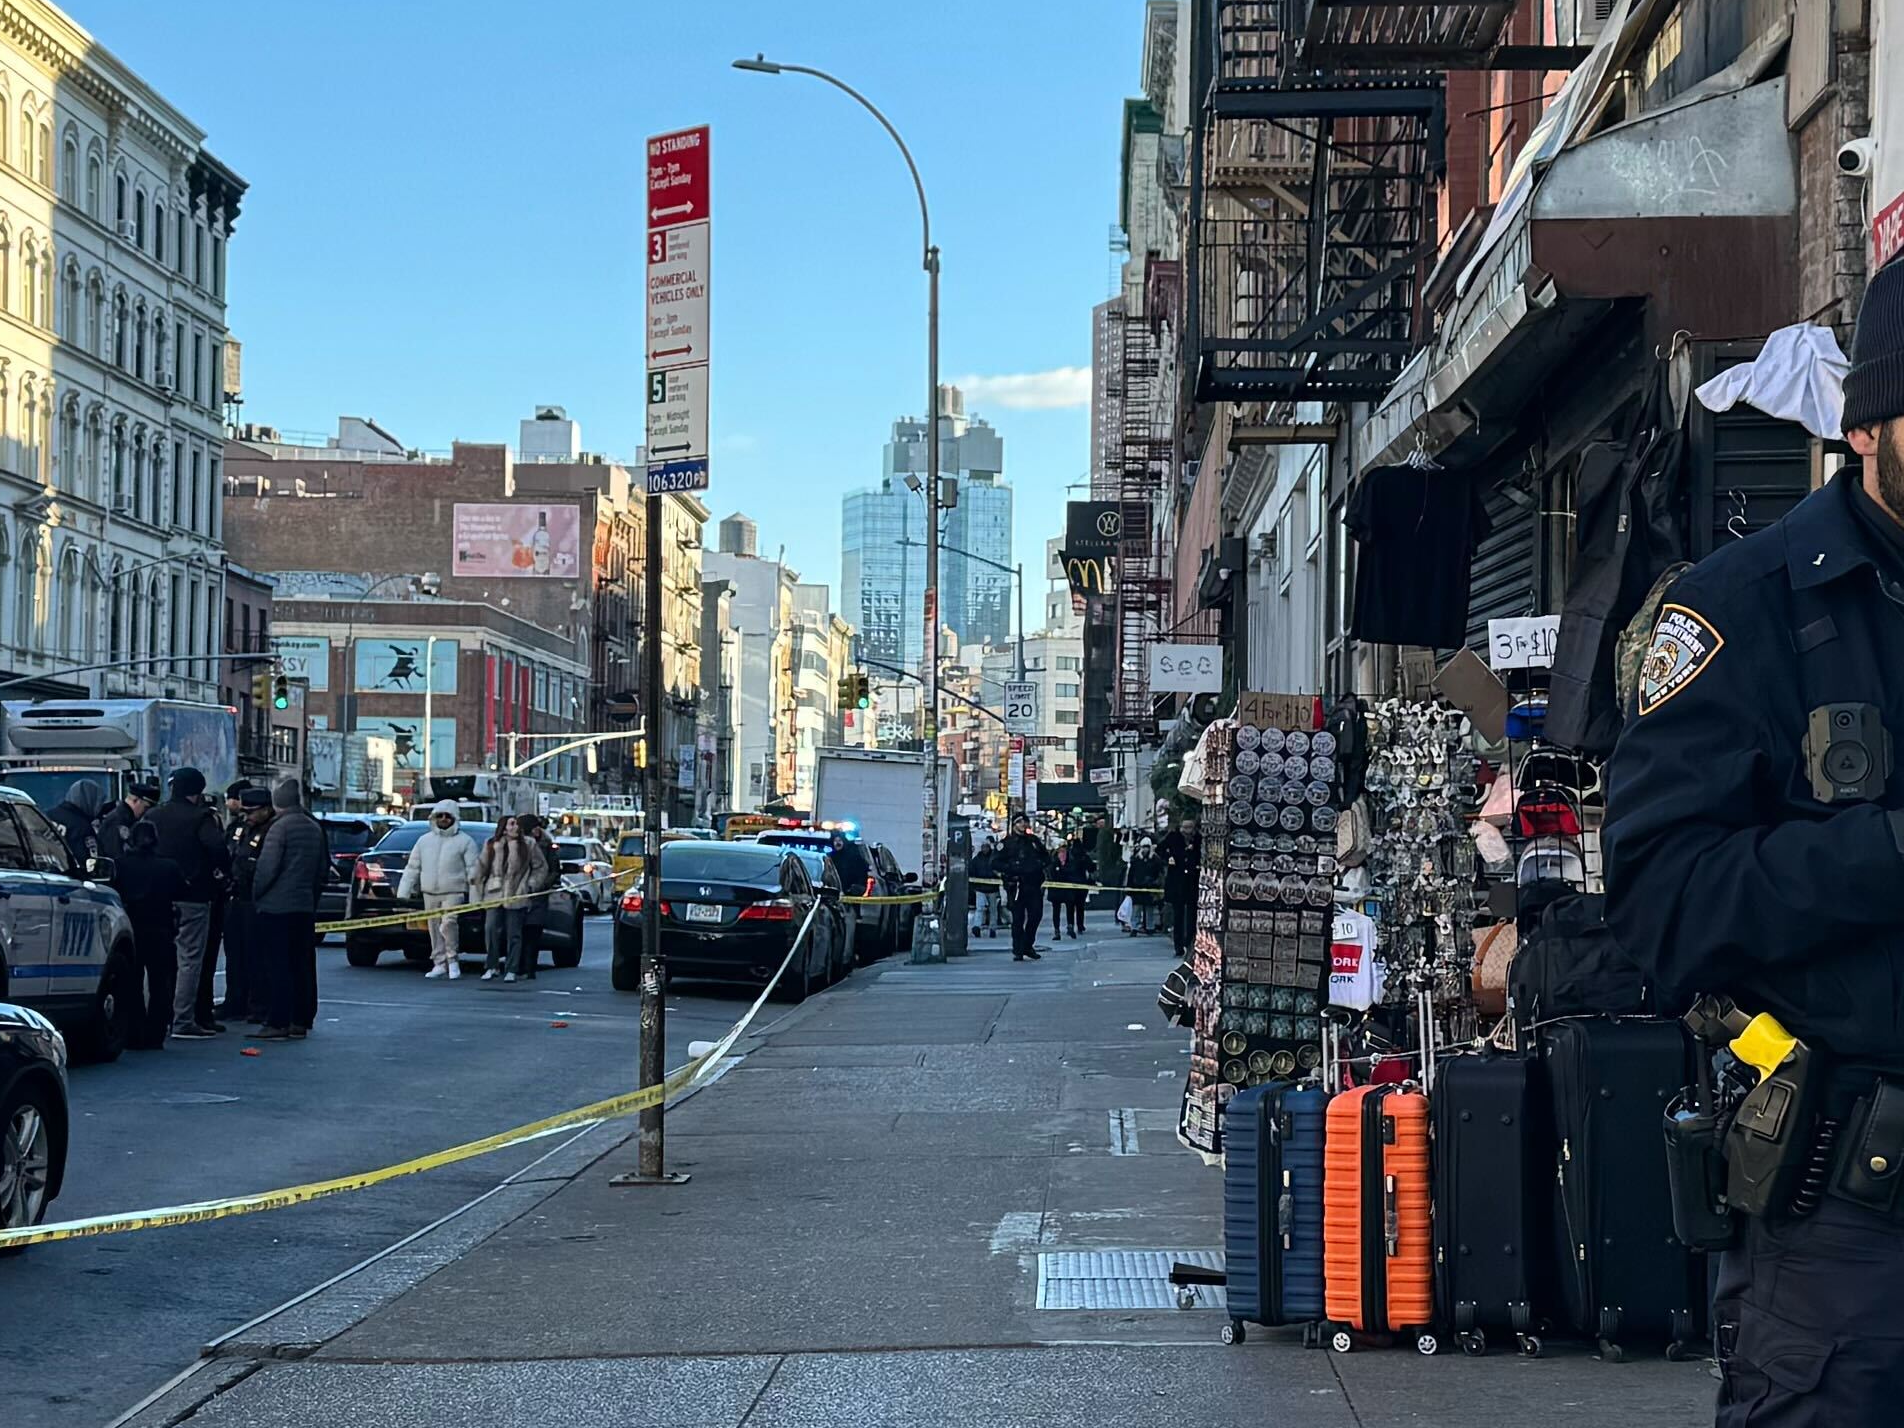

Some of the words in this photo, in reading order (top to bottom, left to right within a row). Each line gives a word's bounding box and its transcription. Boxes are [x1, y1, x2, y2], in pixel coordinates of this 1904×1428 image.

[662, 133, 701, 154] STANDING
[1877, 207, 1904, 259] VAPE
[652, 234, 662, 262] 3
[651, 269, 696, 290] COMMERCIAL
[651, 287, 684, 306] VEHICLES
[686, 284, 704, 299] ONLY
[652, 374, 663, 403] 5
[648, 469, 694, 493] 106320
[1667, 612, 1703, 637] POLICE
[1667, 662, 1698, 689] YORK
[1008, 704, 1034, 719] 20
[1243, 699, 1258, 721] 4
